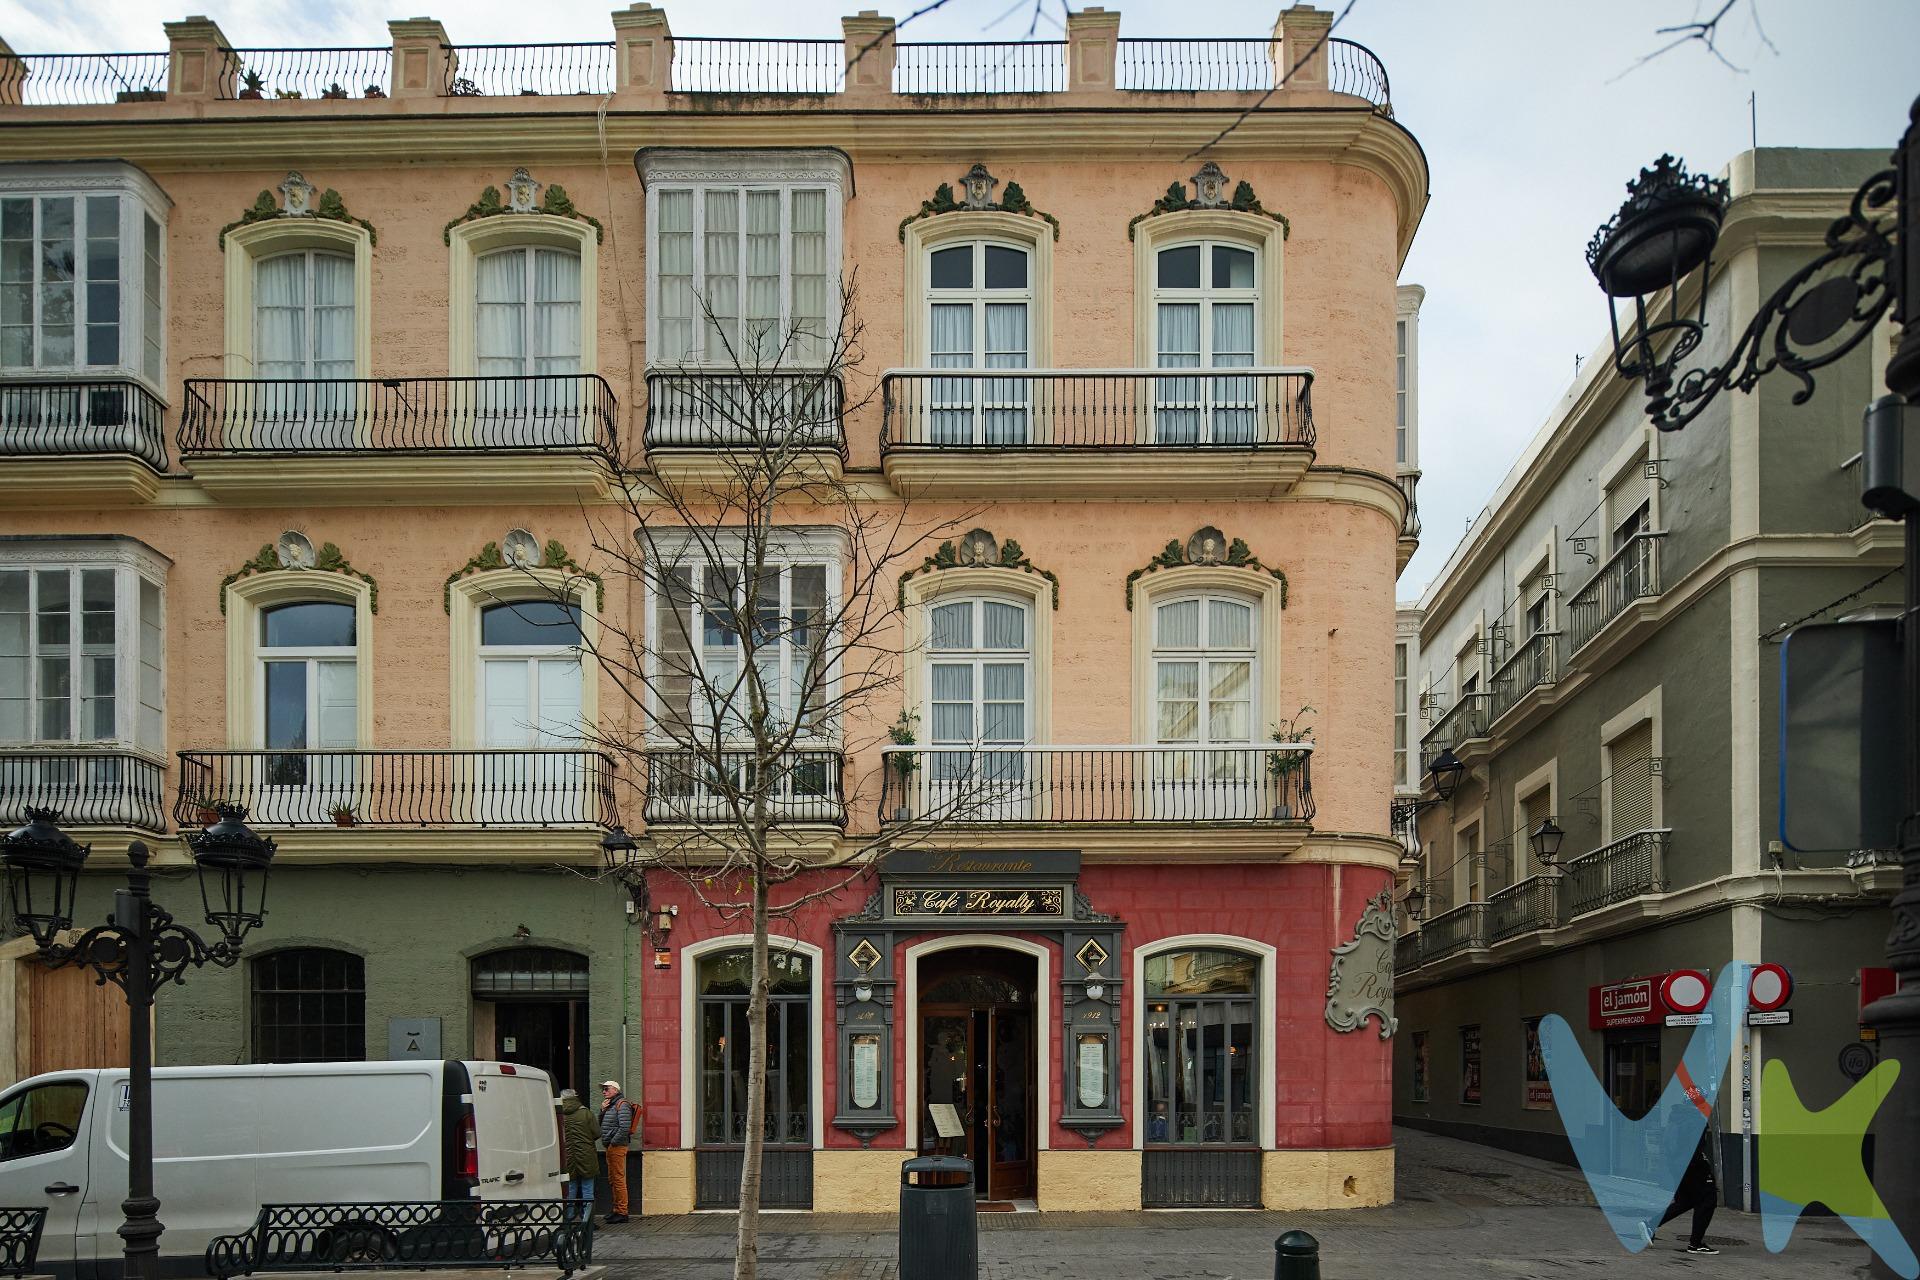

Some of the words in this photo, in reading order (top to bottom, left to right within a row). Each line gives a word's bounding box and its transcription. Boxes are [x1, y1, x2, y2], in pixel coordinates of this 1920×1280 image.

[930, 852, 1032, 872] Restaurante
[922, 891, 960, 914] Café
[966, 891, 1035, 914] Royalty
[1604, 992, 1613, 1007] el
[1614, 986, 1648, 1009] jamón
[1606, 1015, 1645, 1026] SUPERMERCADO
